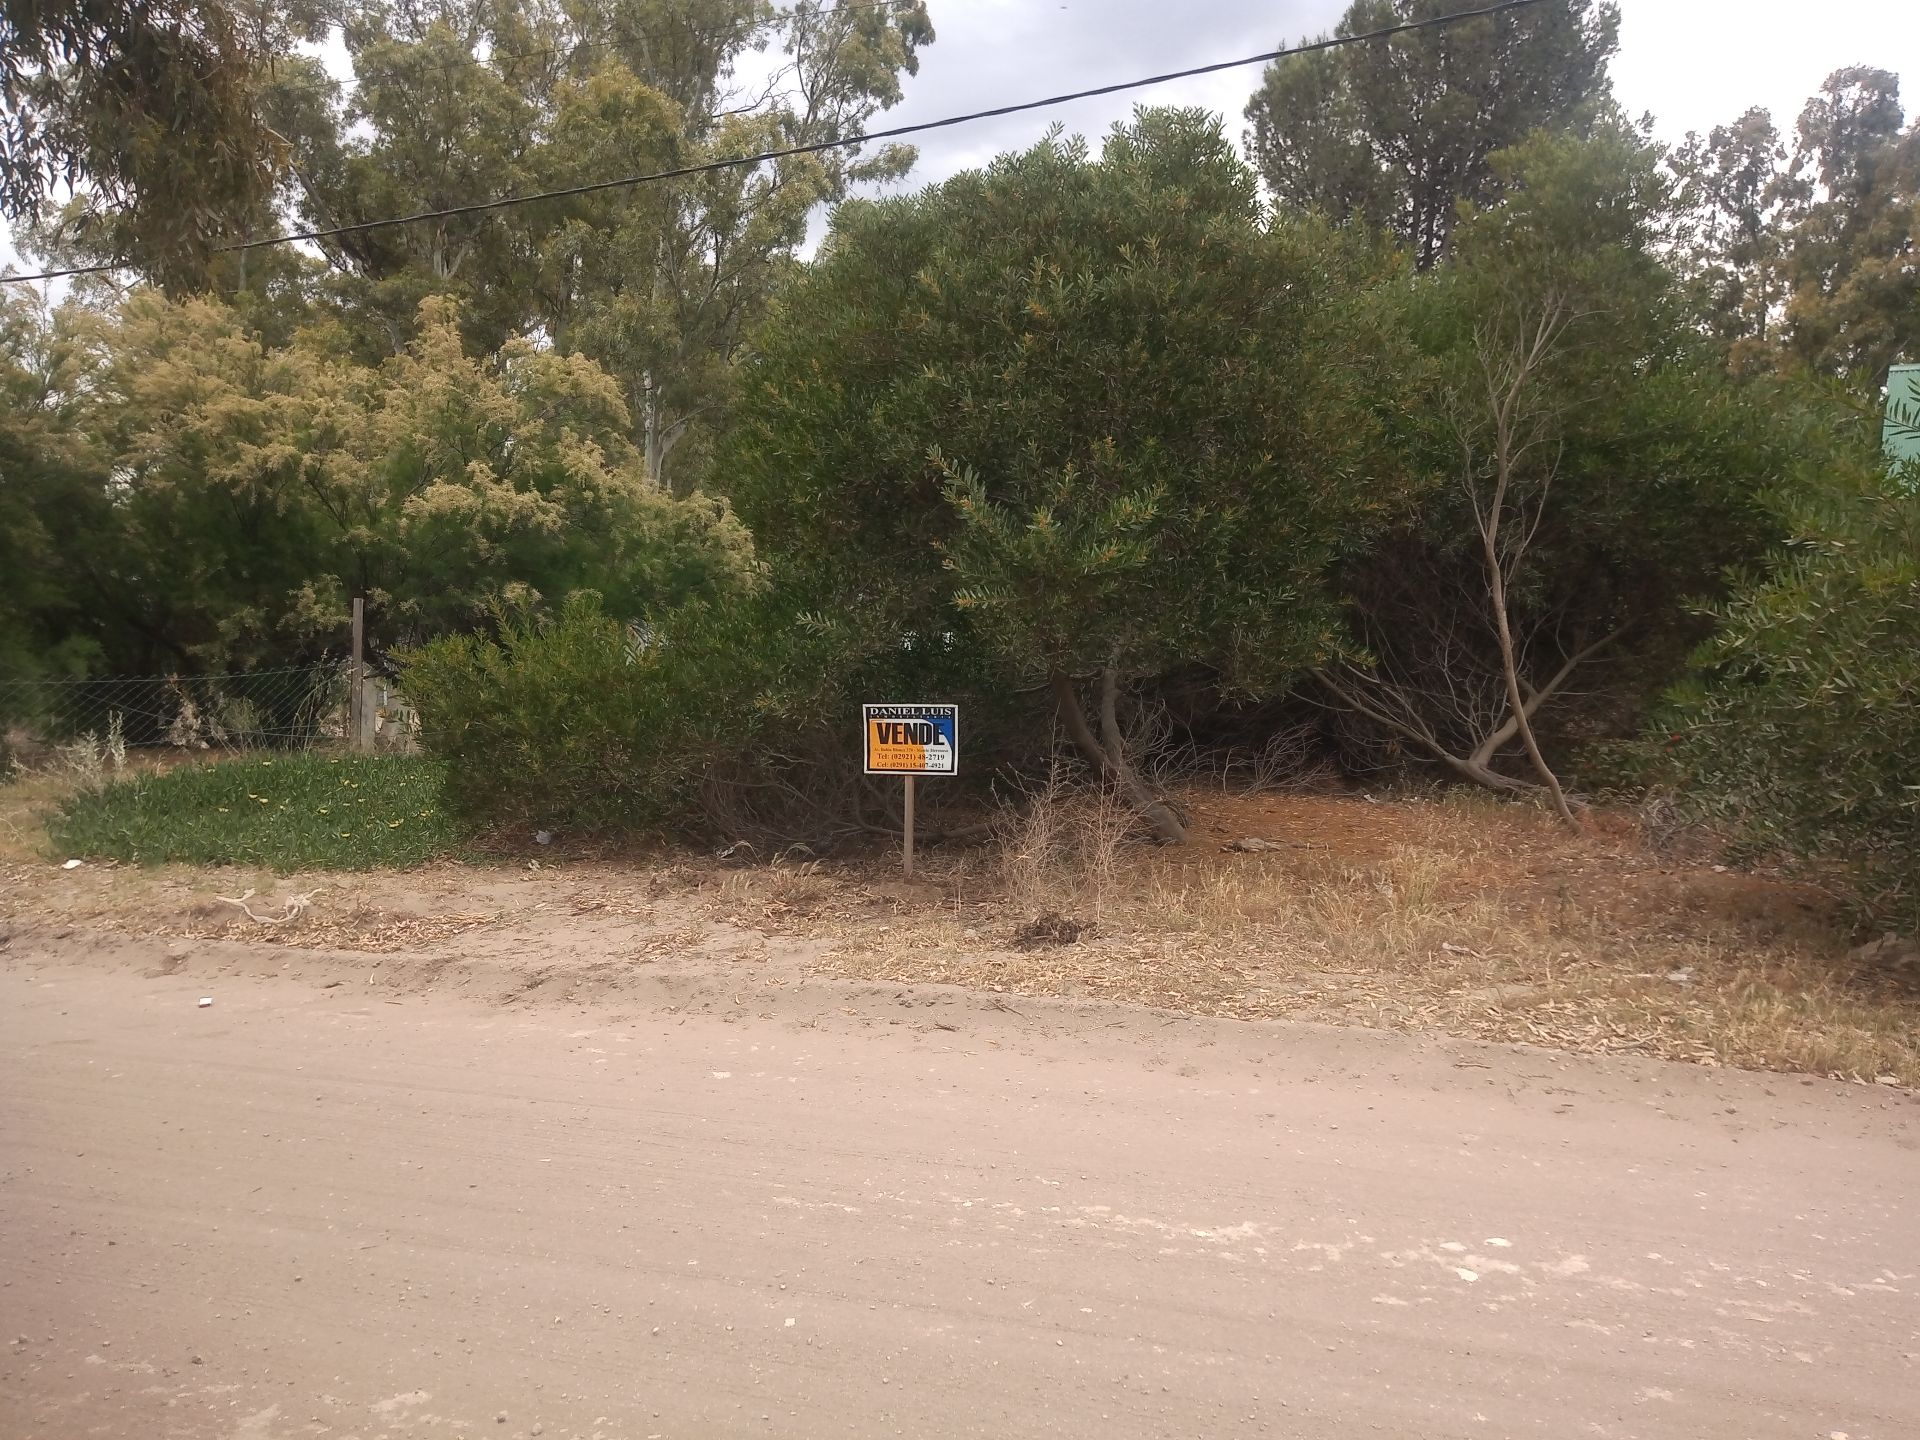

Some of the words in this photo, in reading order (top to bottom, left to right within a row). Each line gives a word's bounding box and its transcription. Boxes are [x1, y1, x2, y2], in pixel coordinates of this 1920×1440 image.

[870, 707, 919, 715] DANIEL
[922, 707, 952, 715] LUIS
[876, 722, 945, 745] VENDE
[891, 753, 916, 761] (02921)
[918, 753, 945, 761] 48-2719
